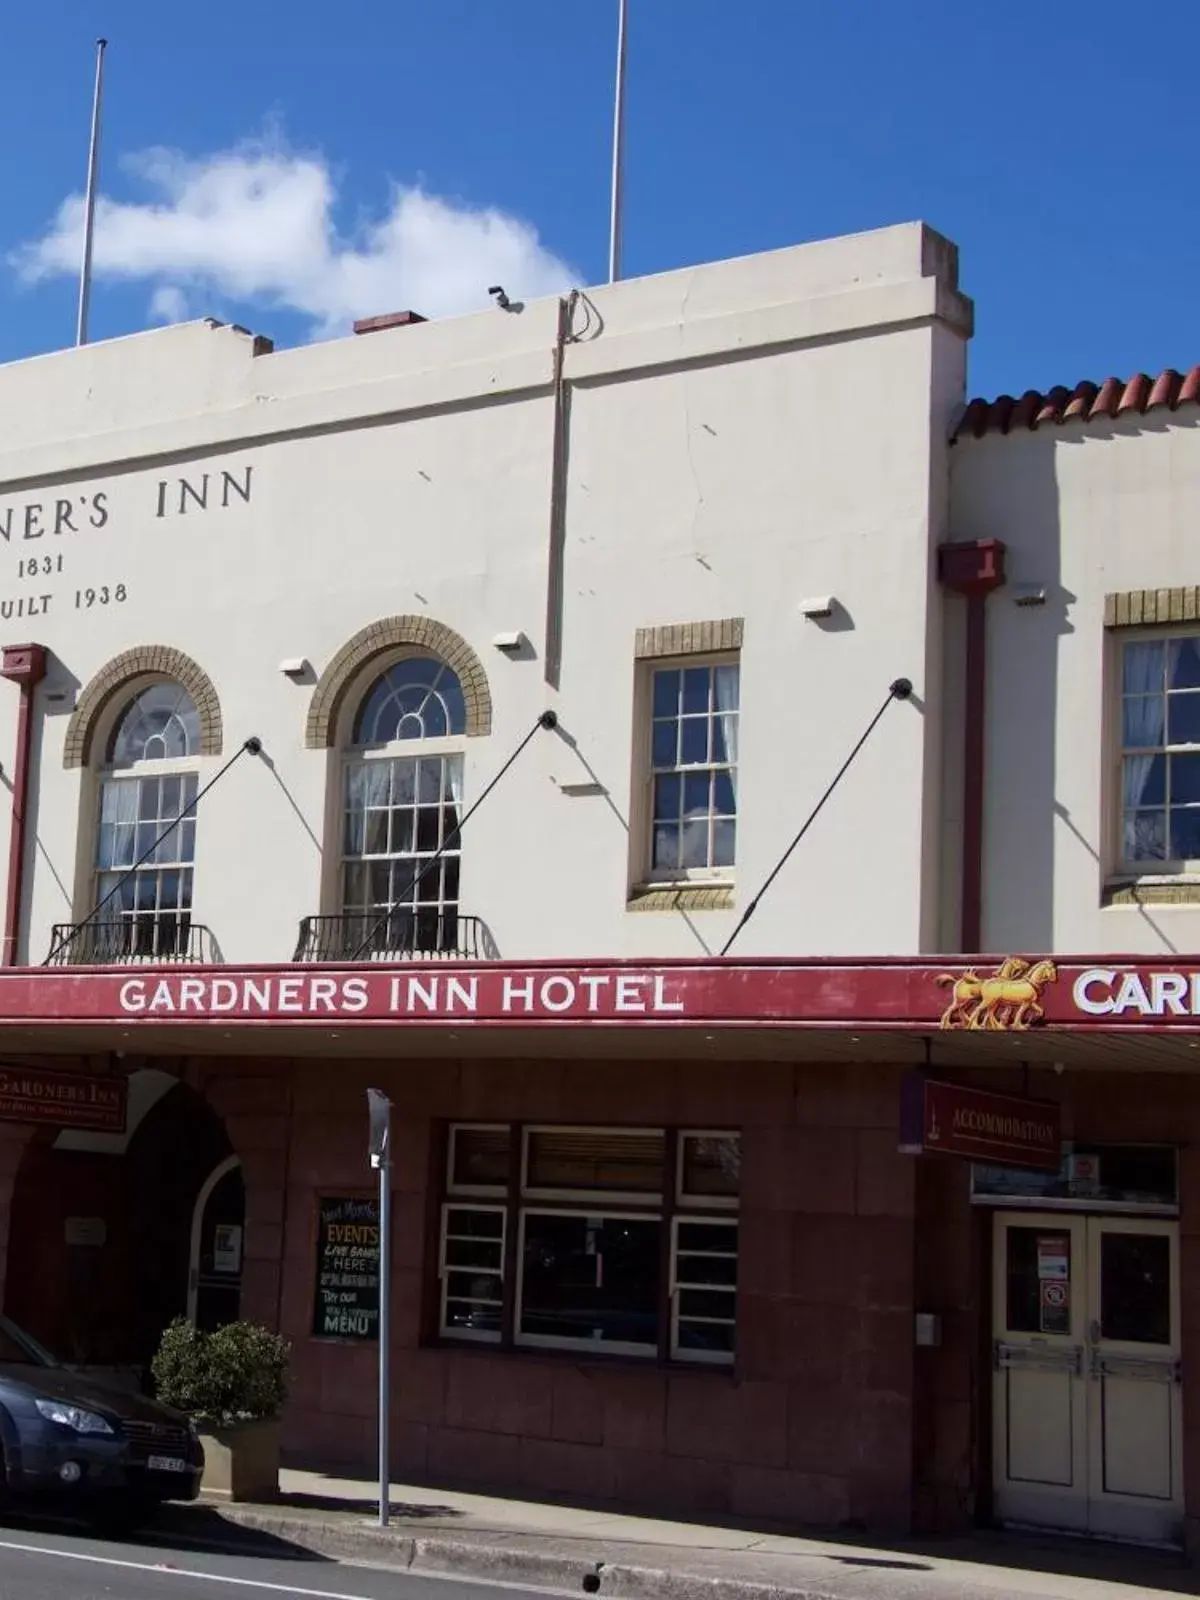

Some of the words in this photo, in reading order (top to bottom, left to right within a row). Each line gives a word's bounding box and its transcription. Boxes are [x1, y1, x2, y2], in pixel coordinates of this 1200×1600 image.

[156, 466, 253, 518] INN
[18, 554, 63, 578] 1831
[75, 584, 127, 609] 1938
[119, 976, 369, 1012] GARDNERS
[390, 977, 478, 1012] INN
[502, 975, 684, 1012] HOTEL
[952, 1107, 1055, 1145] ACCOMMODATION
[327, 1224, 379, 1245] EVENTS
[333, 1257, 366, 1272] HERE
[324, 1315, 369, 1335] MENU
